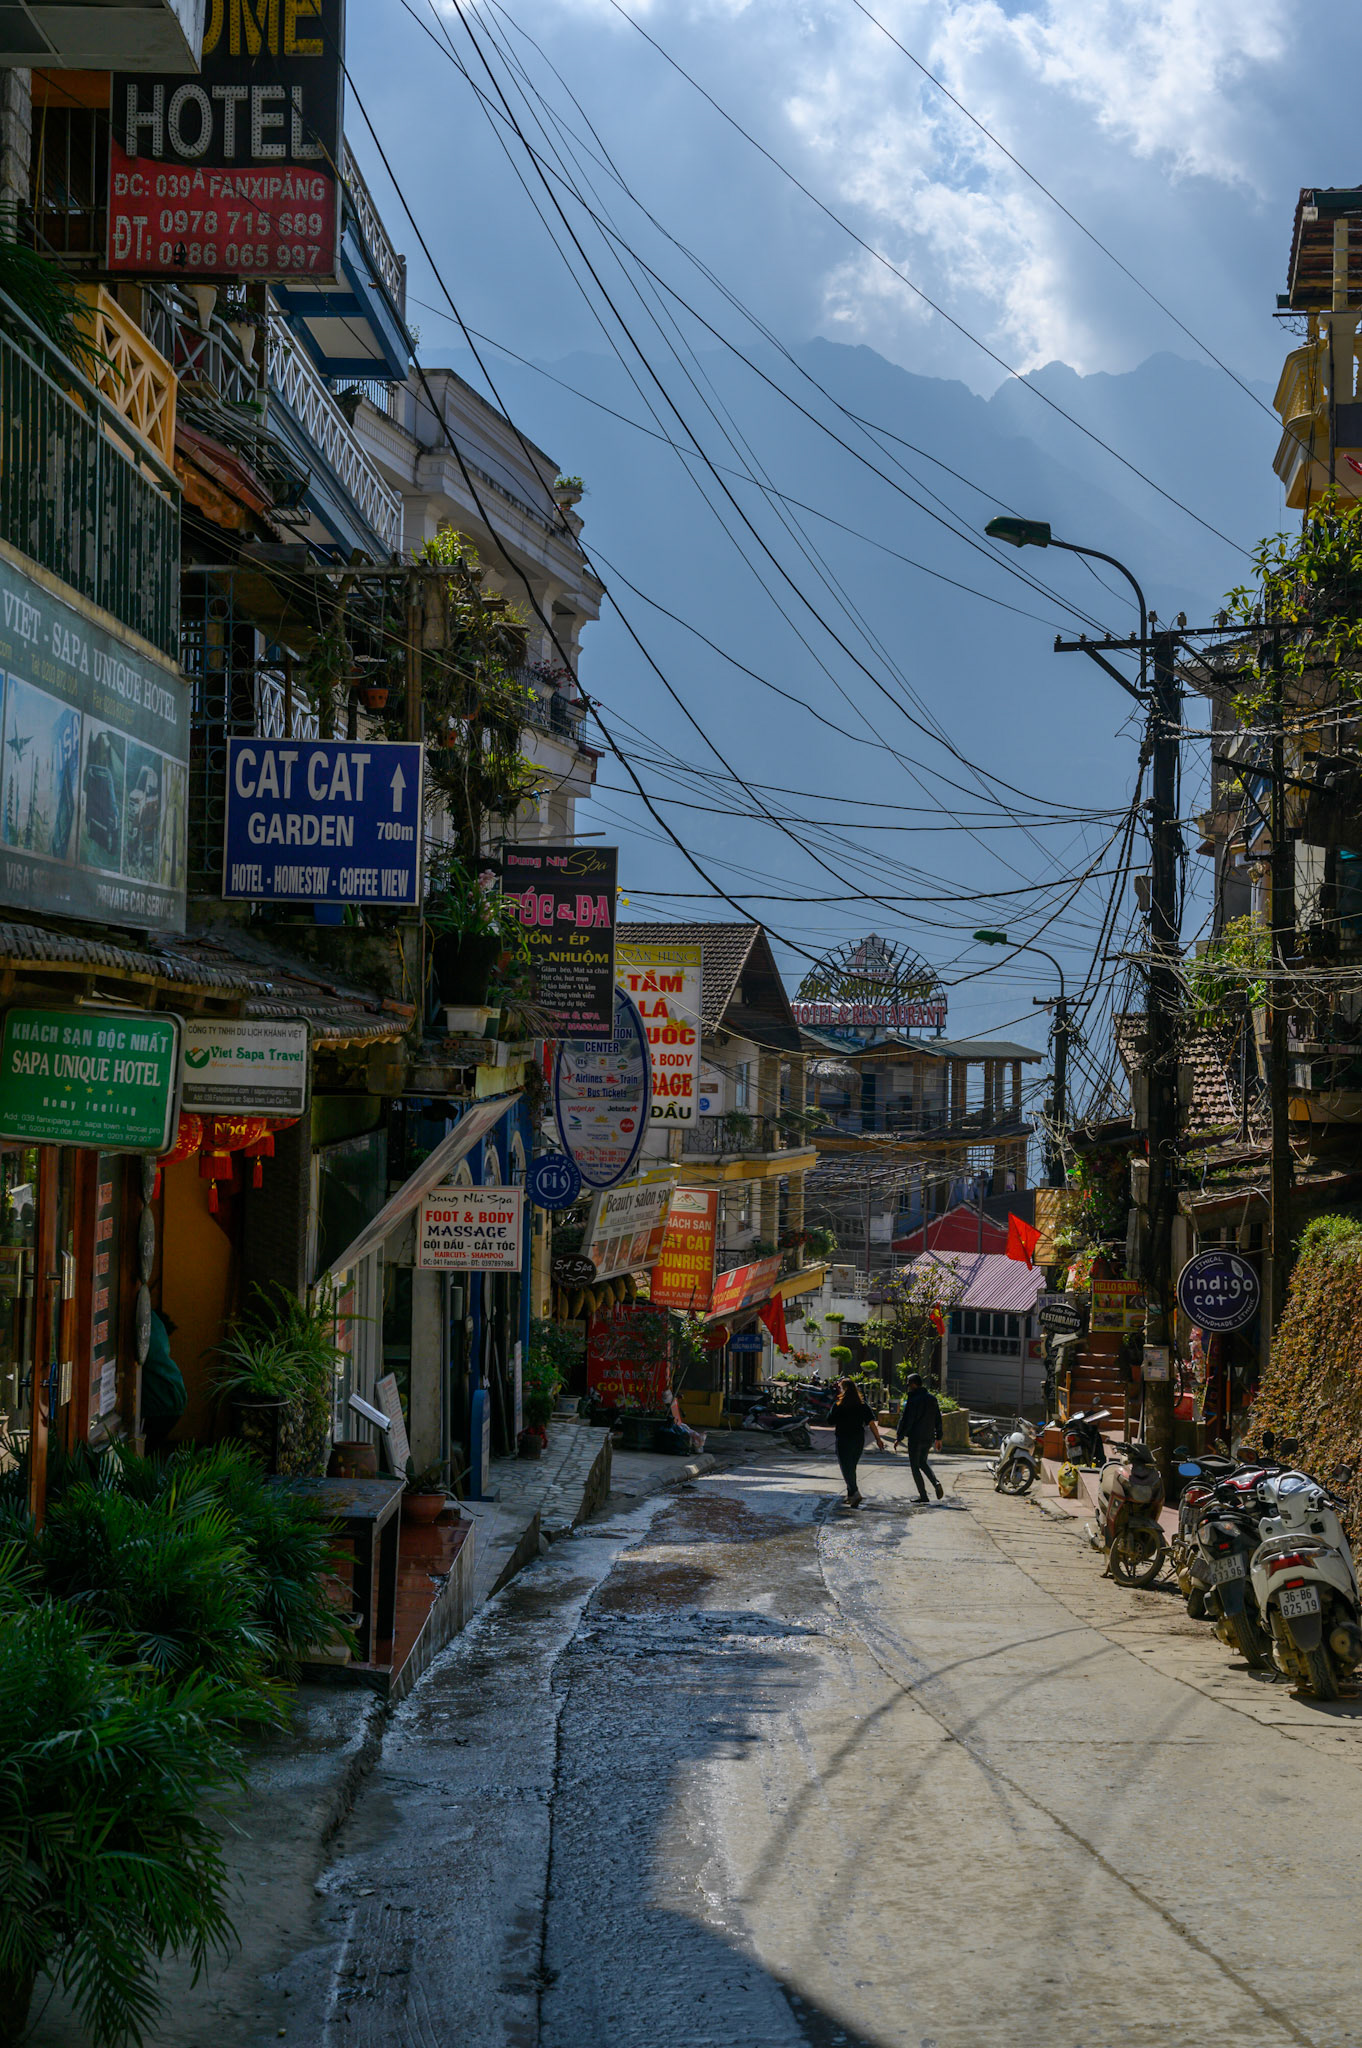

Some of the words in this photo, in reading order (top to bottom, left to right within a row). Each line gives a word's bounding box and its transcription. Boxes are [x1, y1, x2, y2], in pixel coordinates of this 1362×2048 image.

[126, 83, 324, 159] HOTEL
[114, 172, 149, 197] ĐC:
[112, 214, 151, 260] ĐT:
[159, 209, 218, 234] 0978
[226, 211, 271, 236] 715
[278, 212, 323, 237] 689
[224, 243, 270, 266] 065
[276, 243, 321, 268] 997
[3, 589, 41, 648] VIỆT
[52, 622, 89, 676] SAPA
[93, 648, 141, 704] UNIQUE
[143, 679, 177, 725] HOTEL
[235, 748, 299, 799] CAT
[307, 751, 371, 801] CAT
[247, 812, 354, 847] GARDEN
[376, 822, 414, 841] 700m
[507, 855, 541, 868] Dung
[546, 856, 568, 867] Nhi
[561, 850, 608, 876] Spa
[231, 863, 263, 892] HOTEL
[273, 865, 330, 895] HOMESTAY
[339, 867, 378, 896] COFFEE
[381, 869, 409, 897] VIEW
[130, 889, 146, 915] CAR
[556, 903, 576, 921] &
[569, 931, 590, 946] ÉP
[547, 950, 609, 966] NHUỘM
[798, 980, 831, 999] SAPA
[638, 998, 669, 1018] LÁ
[792, 1005, 836, 1025] HOTEL
[838, 1005, 849, 1025] &
[852, 1005, 947, 1026] RESTAURANT
[12, 1022, 59, 1043] KHÁCH
[63, 1027, 93, 1049] SẠN
[97, 1029, 126, 1052] ĐỘC
[130, 1032, 169, 1054] NHẤT
[188, 1025, 207, 1034] CÔNG
[209, 1026, 217, 1035] TY
[218, 1027, 236, 1037] TNHH
[237, 1028, 246, 1036] DU
[248, 1028, 262, 1039] LỊCH
[210, 1046, 232, 1059] Viet
[236, 1047, 264, 1061] Sapa
[269, 1049, 304, 1061] Travel
[585, 1041, 619, 1053] CENTER
[11, 1049, 49, 1076] SAPA
[54, 1053, 110, 1084] UNIQUE
[113, 1059, 161, 1087] HOTEL
[660, 1053, 693, 1067] BODY
[576, 1073, 603, 1084] Airlines
[620, 1074, 638, 1084] Train
[587, 1088, 600, 1098] Bus
[602, 1088, 627, 1098] Tickets
[43, 1096, 76, 1111] Homy
[86, 1101, 136, 1116] feeling
[651, 1102, 691, 1119] ĐẦU
[463, 1193, 485, 1203] Nhi
[487, 1194, 513, 1210] Spa
[606, 1192, 633, 1214] Beauty
[634, 1188, 656, 1208] salon
[425, 1210, 460, 1222] FOOT
[463, 1211, 474, 1223] &
[478, 1212, 514, 1223] BODY
[666, 1216, 691, 1230] HÁCH
[693, 1220, 712, 1233] SẠN
[427, 1225, 507, 1238] MASSAGE
[423, 1239, 440, 1251] GỘI
[497, 1241, 516, 1251] TÓC
[686, 1235, 712, 1251] CAT
[444, 1259, 467, 1268] Fansipan
[573, 1260, 593, 1273] Spa
[657, 1252, 713, 1272] SUNRISE
[1194, 1256, 1222, 1270] ETHICAL
[662, 1271, 702, 1290] HOTEL
[1095, 1282, 1116, 1292] HELLO
[1189, 1275, 1253, 1299] indigo
[1193, 1294, 1227, 1306] cat
[1040, 1312, 1081, 1328] RESTAURANTS
[1195, 1313, 1233, 1327] HANDMADE
[1284, 1588, 1312, 1603] 36-B6
[1283, 1600, 1318, 1616] 825.19
